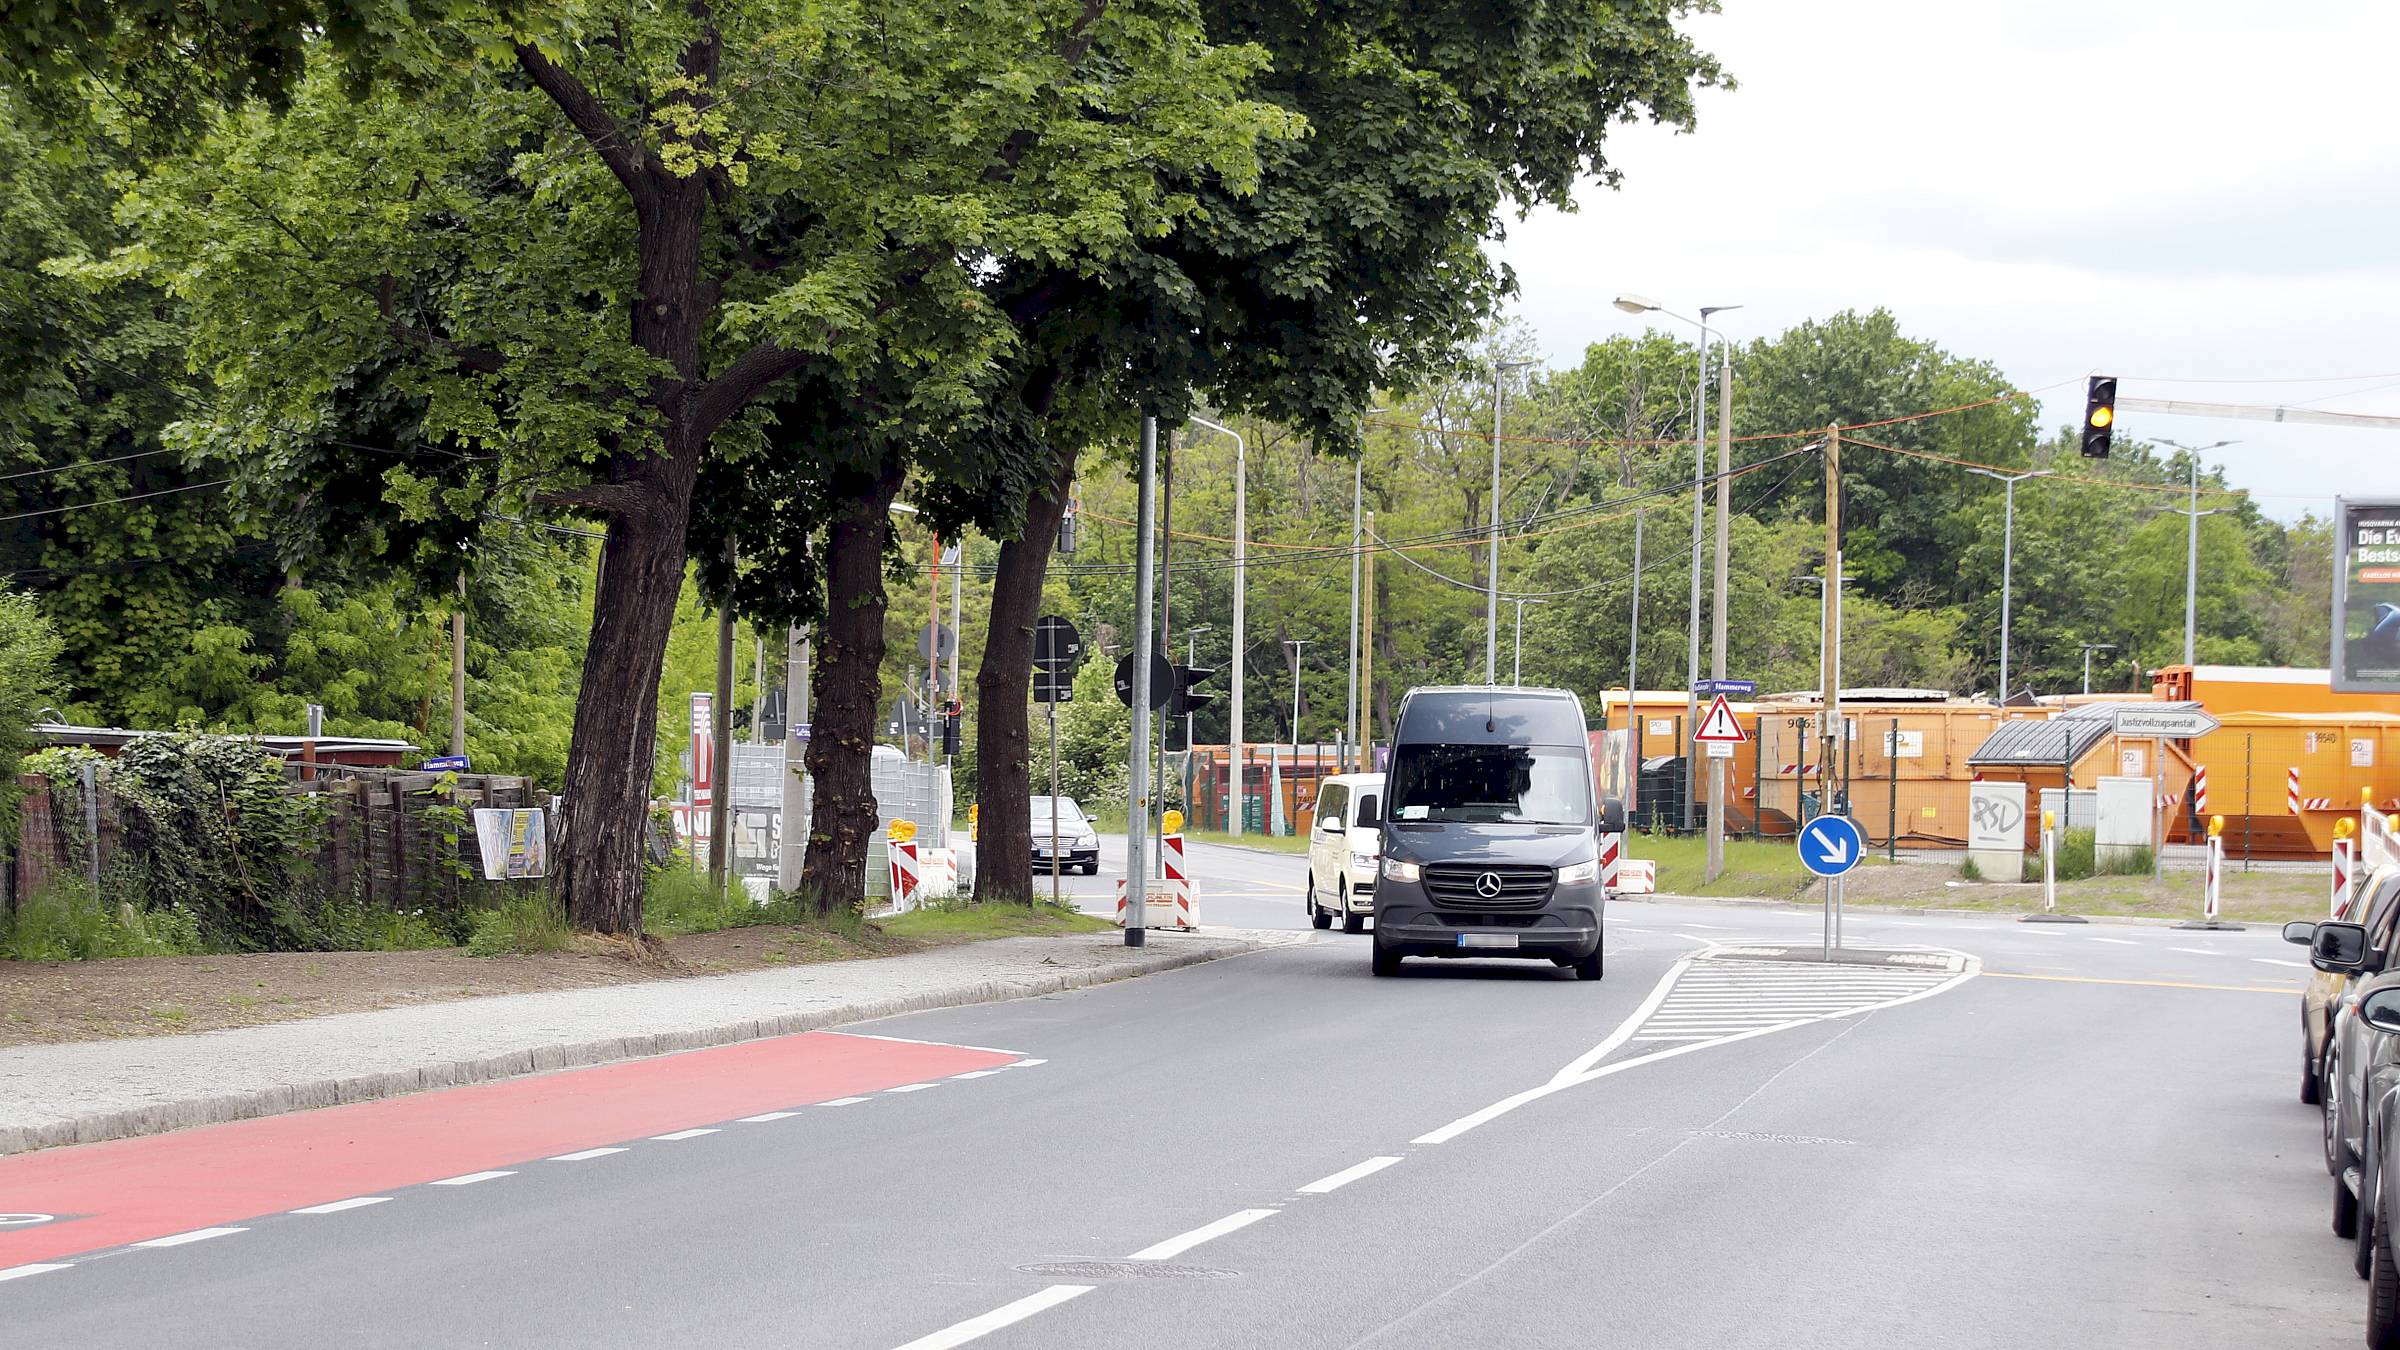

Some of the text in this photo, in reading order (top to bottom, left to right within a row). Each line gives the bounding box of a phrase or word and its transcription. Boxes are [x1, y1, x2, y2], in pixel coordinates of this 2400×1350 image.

[2358, 529, 2382, 545] Die
[2358, 547, 2400, 563] Bests
[1715, 682, 1751, 692] Hammerweg
[2120, 717, 2195, 729] Justizvollzugsanstalt
[772, 813, 781, 839] S
